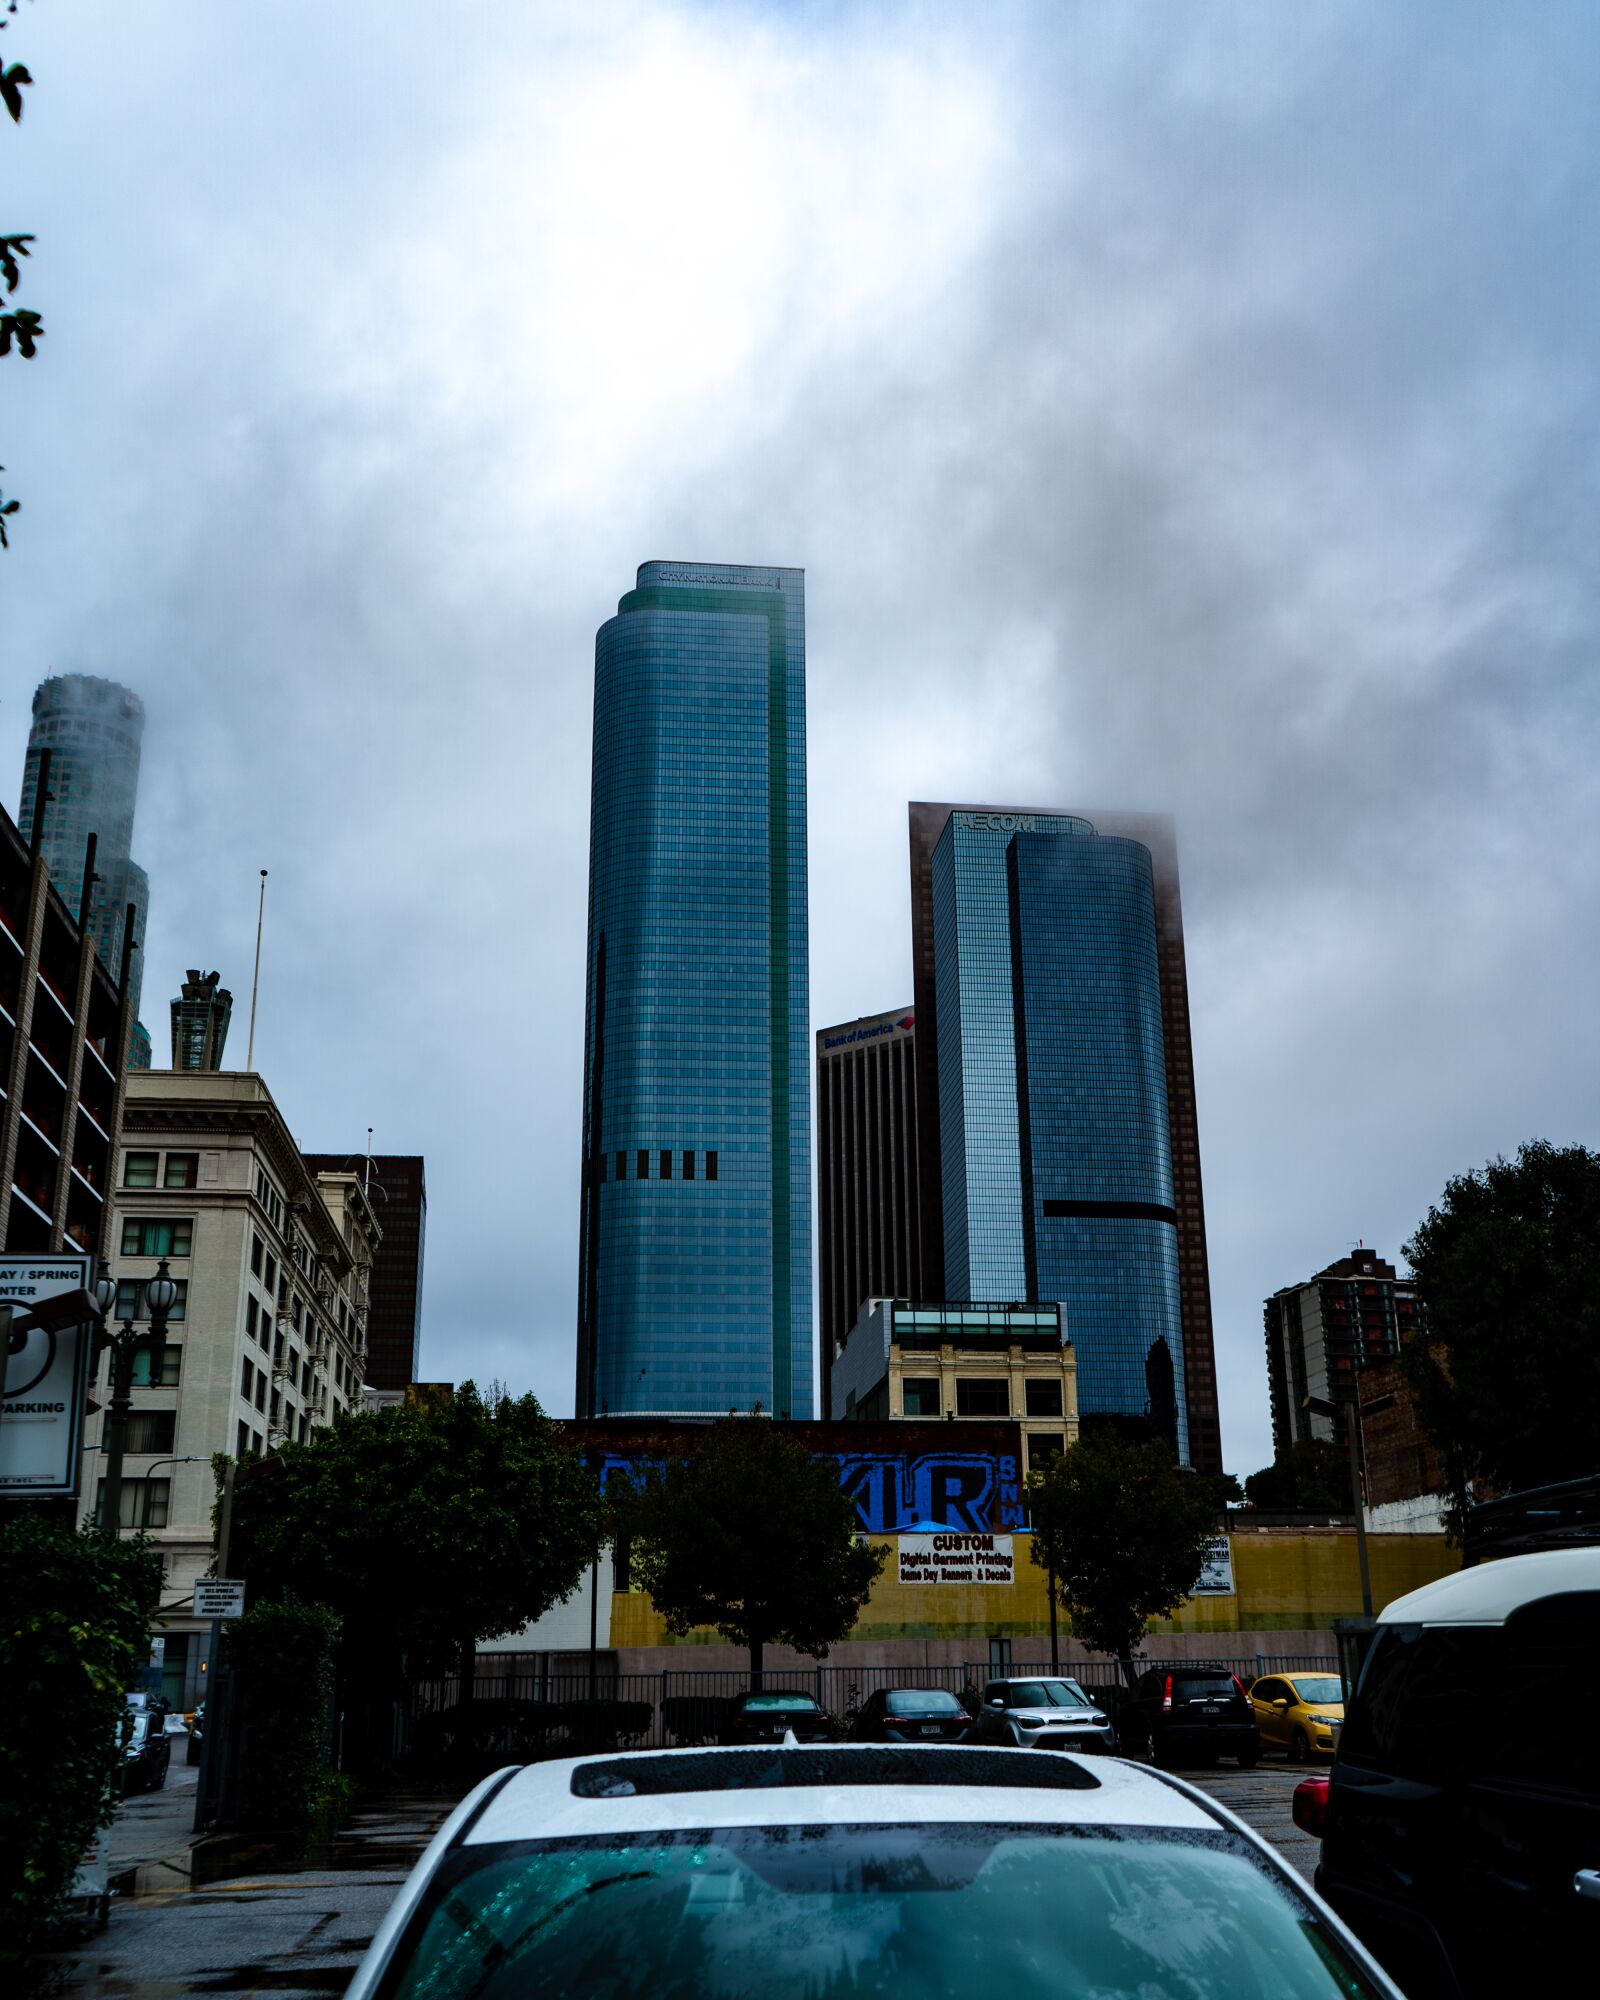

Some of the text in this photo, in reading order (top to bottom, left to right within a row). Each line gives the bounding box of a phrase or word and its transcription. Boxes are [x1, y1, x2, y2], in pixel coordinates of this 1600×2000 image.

[659, 572, 773, 587] CITY NATIONAL BANK
[959, 814, 1035, 832] AECOM
[824, 1023, 894, 1049] Bank of America
[28, 1270, 79, 1280] SPRING
[933, 1535, 994, 1551] CUSTOM
[900, 1552, 1013, 1568] Digital Garment Printing
[900, 1568, 1011, 1583] Same Day Banners & Decals
